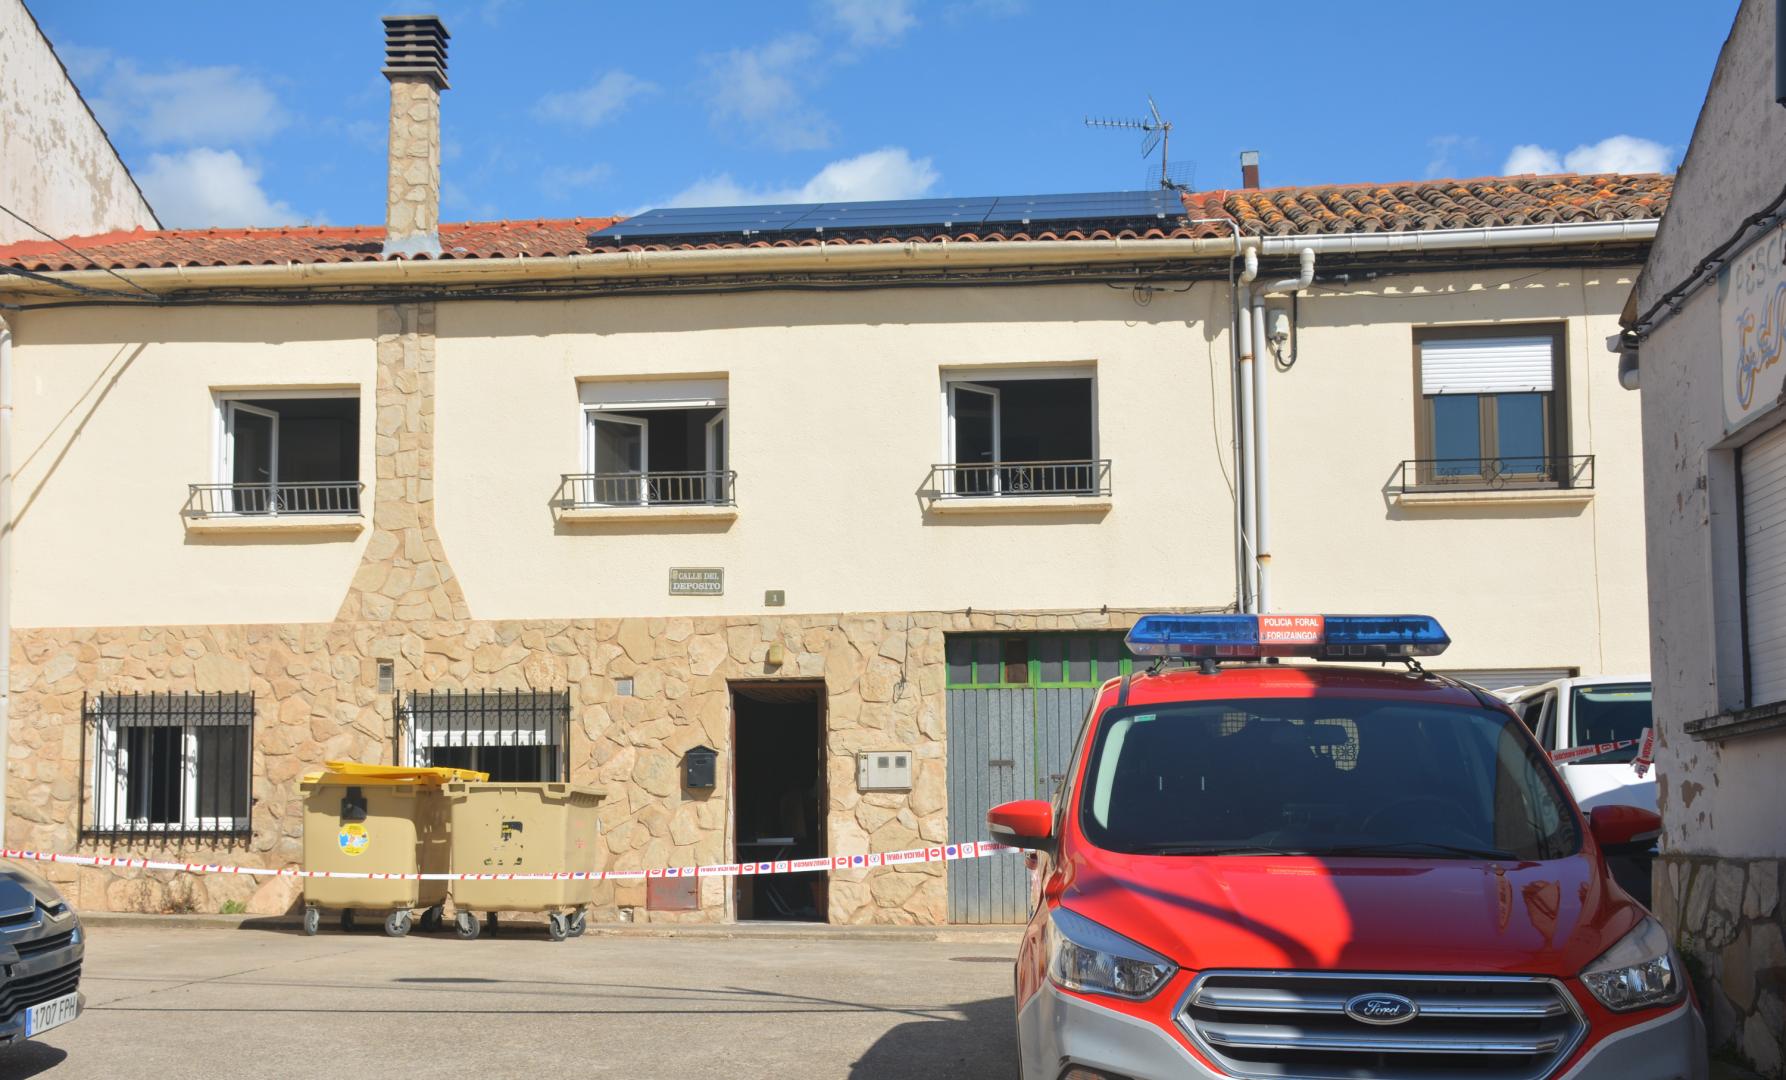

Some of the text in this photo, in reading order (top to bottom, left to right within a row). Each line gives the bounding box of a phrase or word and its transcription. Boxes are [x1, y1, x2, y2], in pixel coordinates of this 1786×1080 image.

[678, 572, 720, 580] CALLE DEL
[672, 582, 721, 590] DEPOSITO
[1263, 618, 1319, 627] POLICIA FORAL
[1266, 631, 1318, 640] FORUZAINGOA
[1363, 1000, 1401, 1016] Ford
[35, 1002, 58, 1030] 1707
